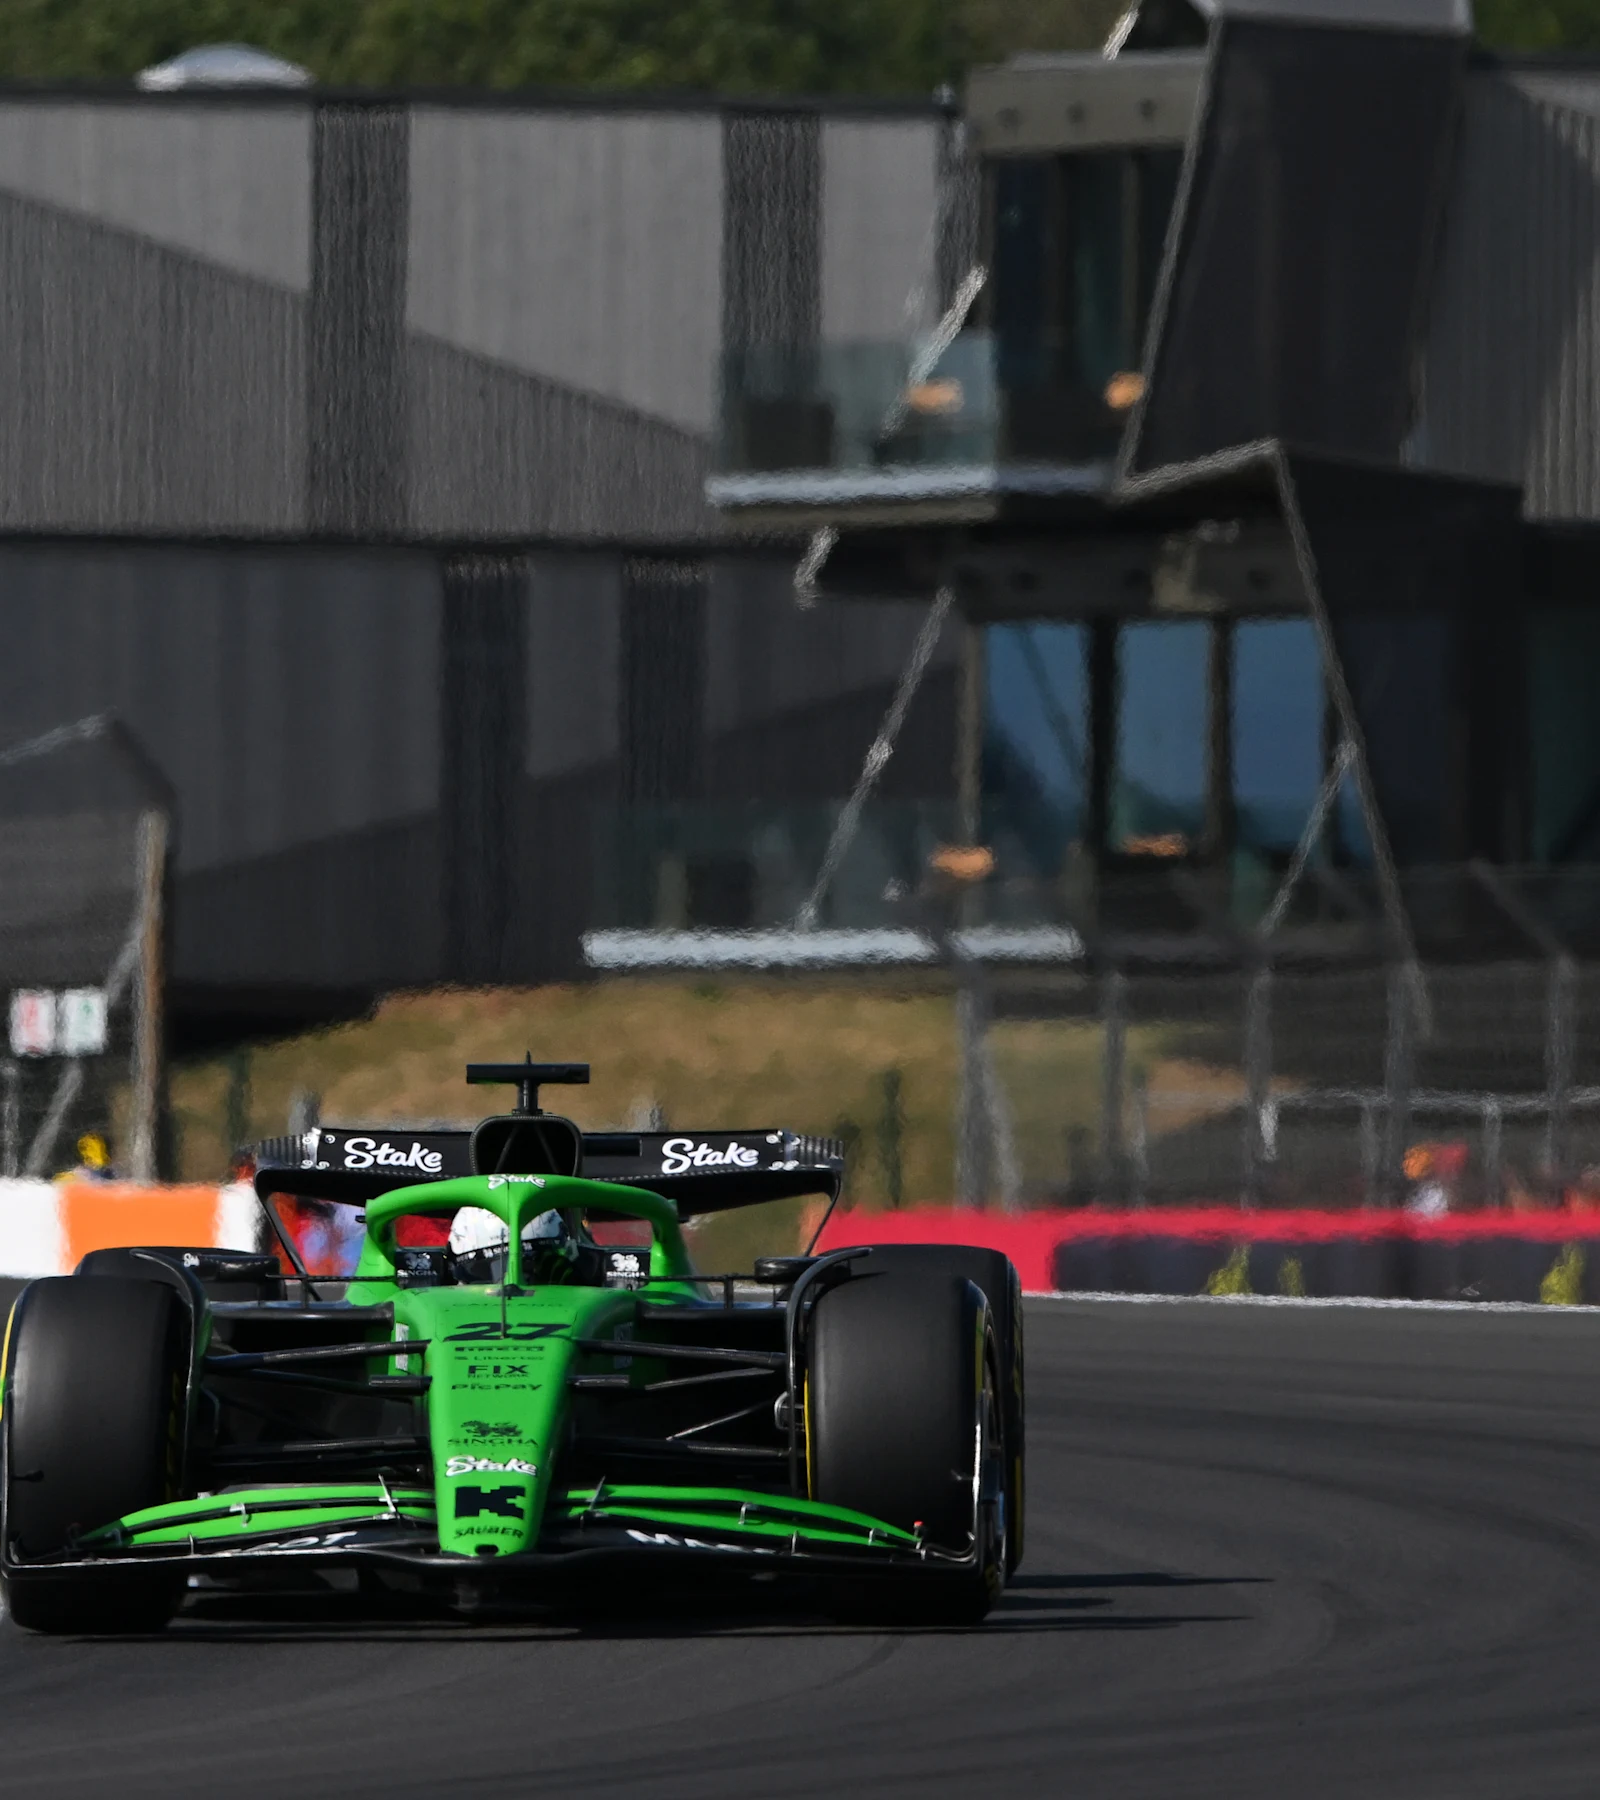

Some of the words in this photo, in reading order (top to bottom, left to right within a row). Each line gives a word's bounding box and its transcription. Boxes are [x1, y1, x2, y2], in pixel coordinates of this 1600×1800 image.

[344, 1137, 442, 1172] Stake
[661, 1138, 759, 1174] Stake
[488, 1174, 546, 1190] Stake
[397, 1269, 438, 1277] SINGHA
[443, 1322, 571, 1342] 27
[468, 1365, 529, 1374] FIX
[447, 1438, 539, 1447] SINGHA
[445, 1455, 537, 1477] Stake
[455, 1486, 525, 1519] K
[454, 1525, 524, 1539] SAUBER
